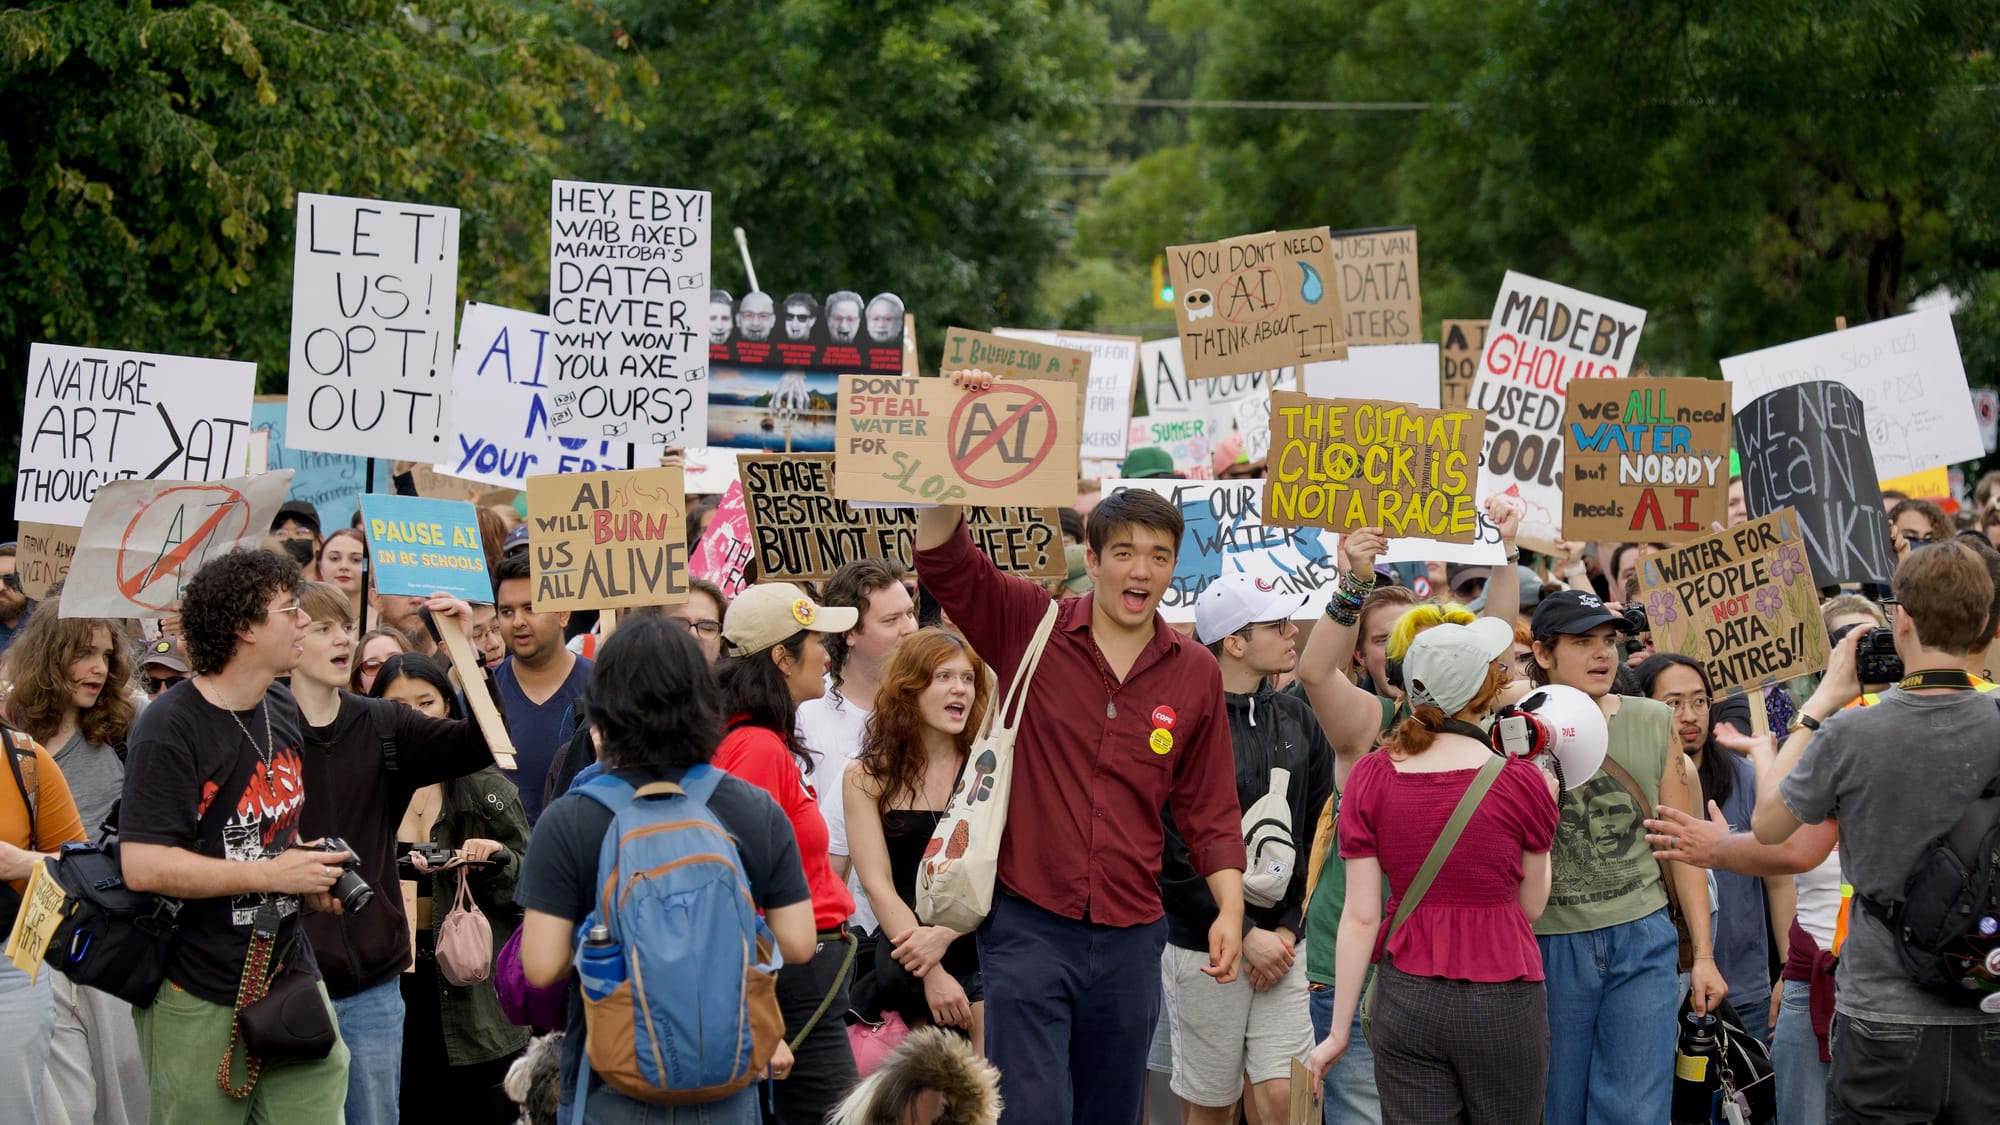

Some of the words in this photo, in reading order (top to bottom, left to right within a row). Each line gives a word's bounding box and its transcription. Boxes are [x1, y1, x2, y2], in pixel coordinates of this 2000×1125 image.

[559, 187, 616, 218] HEY,
[629, 189, 704, 222] EBY!
[310, 204, 446, 264] LET!
[556, 218, 620, 243] WAB
[632, 224, 697, 247] AXED
[1335, 238, 1376, 260] JUST
[555, 241, 683, 263] MANITOBA'S
[1178, 250, 1220, 284] YOU
[1284, 236, 1324, 256] NEED
[337, 272, 433, 319] US!
[559, 262, 671, 295] DATA
[1228, 270, 1275, 319] AI
[1342, 260, 1411, 304] DATA
[553, 297, 691, 331] CENTER,
[1500, 290, 1594, 351] MADE
[1589, 314, 1638, 360] BY
[305, 325, 440, 378] OPT!
[555, 331, 612, 350] WHY
[621, 331, 698, 352] WON'T
[950, 336, 967, 363] I
[1187, 331, 1250, 361] THINK
[1254, 314, 1300, 345] ABOUT
[1298, 318, 1336, 358] IT!
[36, 357, 156, 405] NATURE
[555, 354, 608, 380] YOU
[620, 354, 678, 379] AXE
[851, 378, 920, 396] DON'T
[309, 384, 441, 442] OUT!
[578, 385, 692, 432] OURS?
[850, 396, 929, 417] STEAL
[1279, 404, 1348, 439] THE
[1578, 401, 1620, 420] we
[1623, 389, 1675, 424] ALL
[1677, 402, 1726, 423] need
[1738, 393, 1785, 458] WE
[1797, 381, 1861, 439] NEED
[31, 405, 135, 463] ART
[850, 418, 927, 436] WATER
[956, 402, 1043, 463] AI
[850, 437, 887, 455] FOR
[20, 469, 138, 503] THOUG
[747, 461, 826, 494] STAGE
[882, 451, 966, 501] SLOP
[1575, 464, 1607, 481] but
[1619, 453, 1724, 487] NOBODY
[571, 480, 610, 512] AI
[1209, 486, 1261, 520] OUR
[1271, 482, 1348, 524] NOT
[1344, 489, 1368, 529] A
[1377, 489, 1476, 537] RACE
[1573, 500, 1624, 518] needs
[371, 519, 445, 547] PAUSE
[453, 526, 479, 549] AI
[536, 514, 588, 533] WILL
[593, 509, 668, 545] BURN
[1192, 524, 1307, 557] WATER
[377, 550, 395, 564] IN
[399, 551, 419, 567] BC
[421, 553, 484, 573] SCHOOLS
[538, 541, 573, 570] US
[755, 526, 813, 575] BUT
[814, 527, 867, 572] NOT
[1655, 539, 1732, 583] WATER
[1733, 522, 1781, 556] FOR
[537, 574, 575, 602] ALL
[578, 542, 688, 599] ALIVE
[1676, 558, 1770, 616] PEOPLE
[1712, 594, 1749, 624] NOT
[1705, 615, 1769, 657] DATA
[1700, 622, 1804, 692] ENTRES!!
